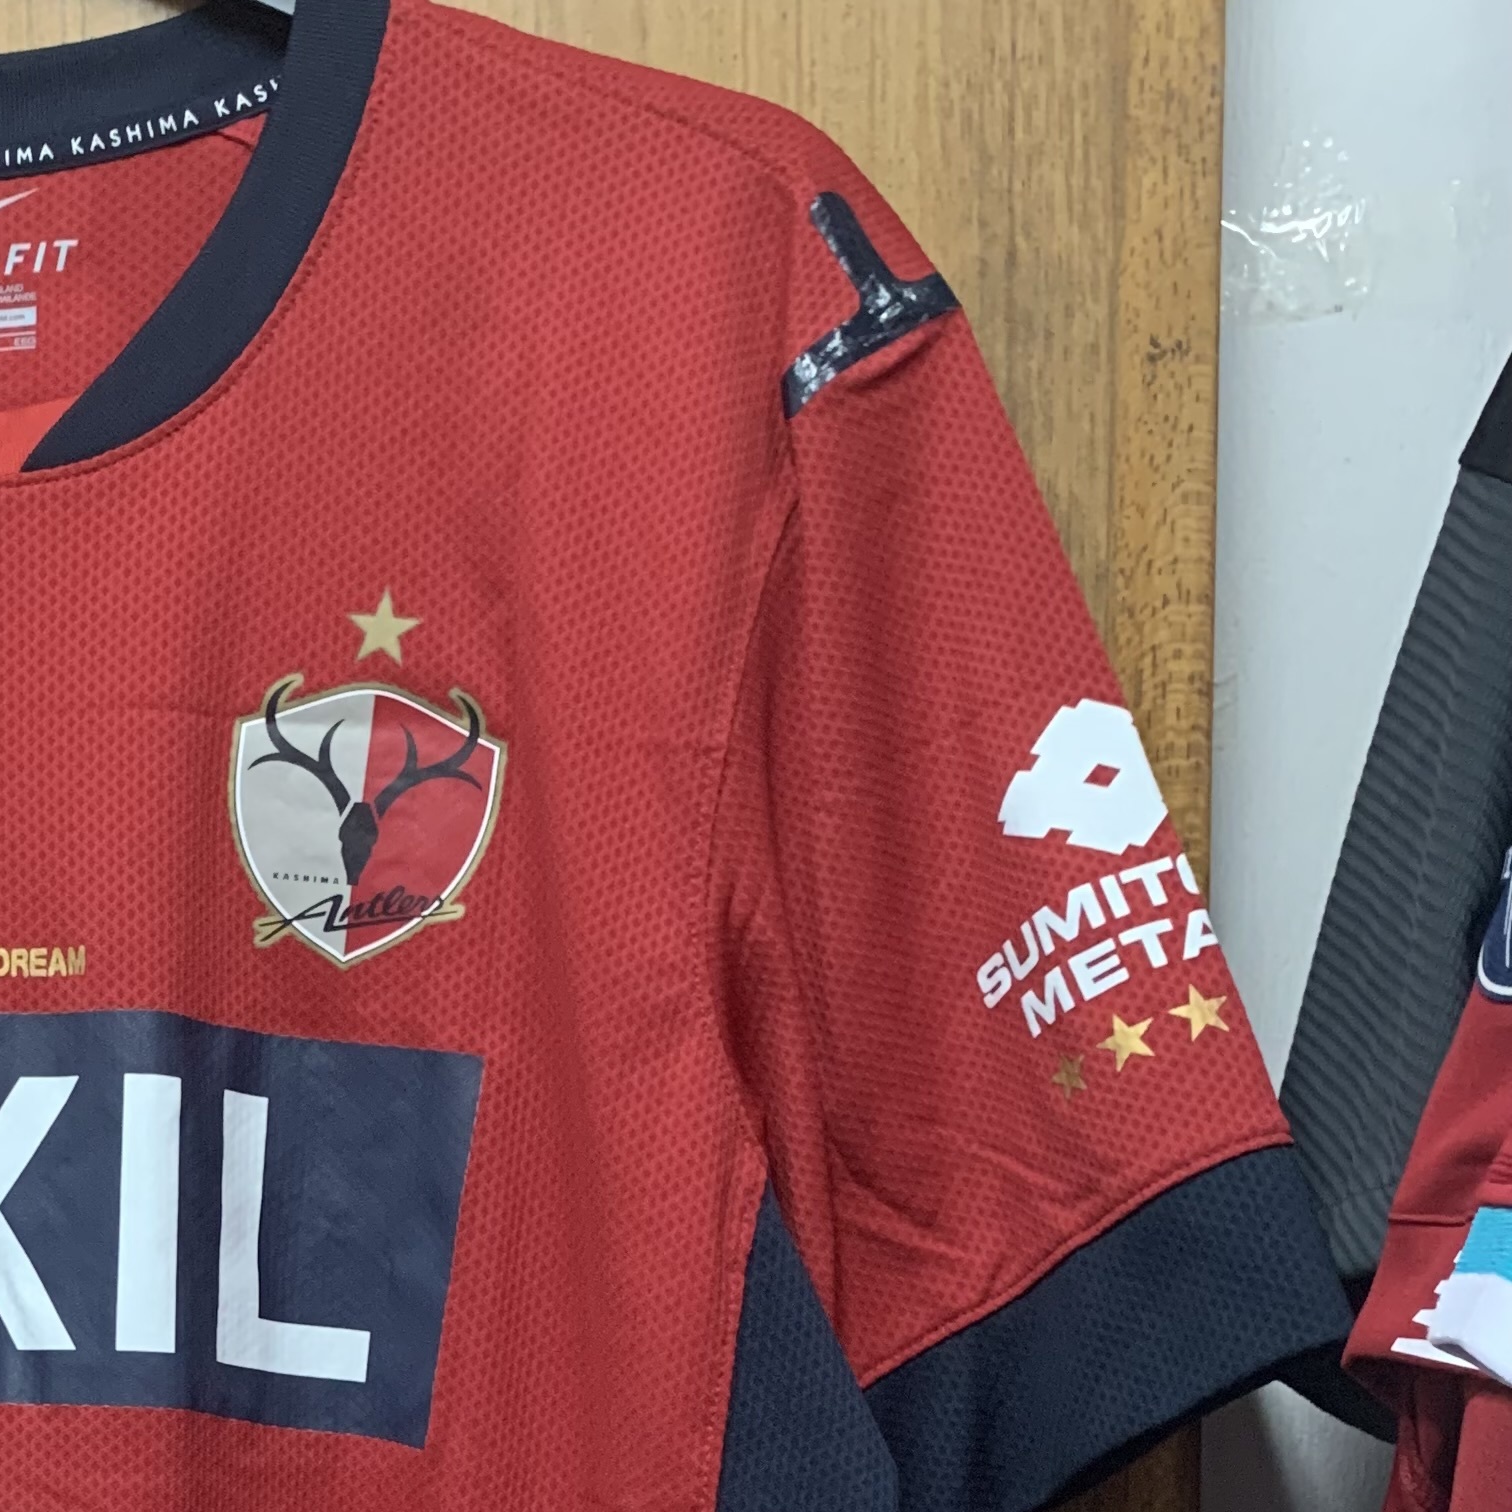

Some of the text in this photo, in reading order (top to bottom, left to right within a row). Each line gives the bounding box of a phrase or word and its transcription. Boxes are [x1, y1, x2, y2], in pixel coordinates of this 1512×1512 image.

[70, 109, 199, 155] KASHIMA
[272, 872, 340, 885] KASHIMA
[258, 885, 458, 942] Antlers
